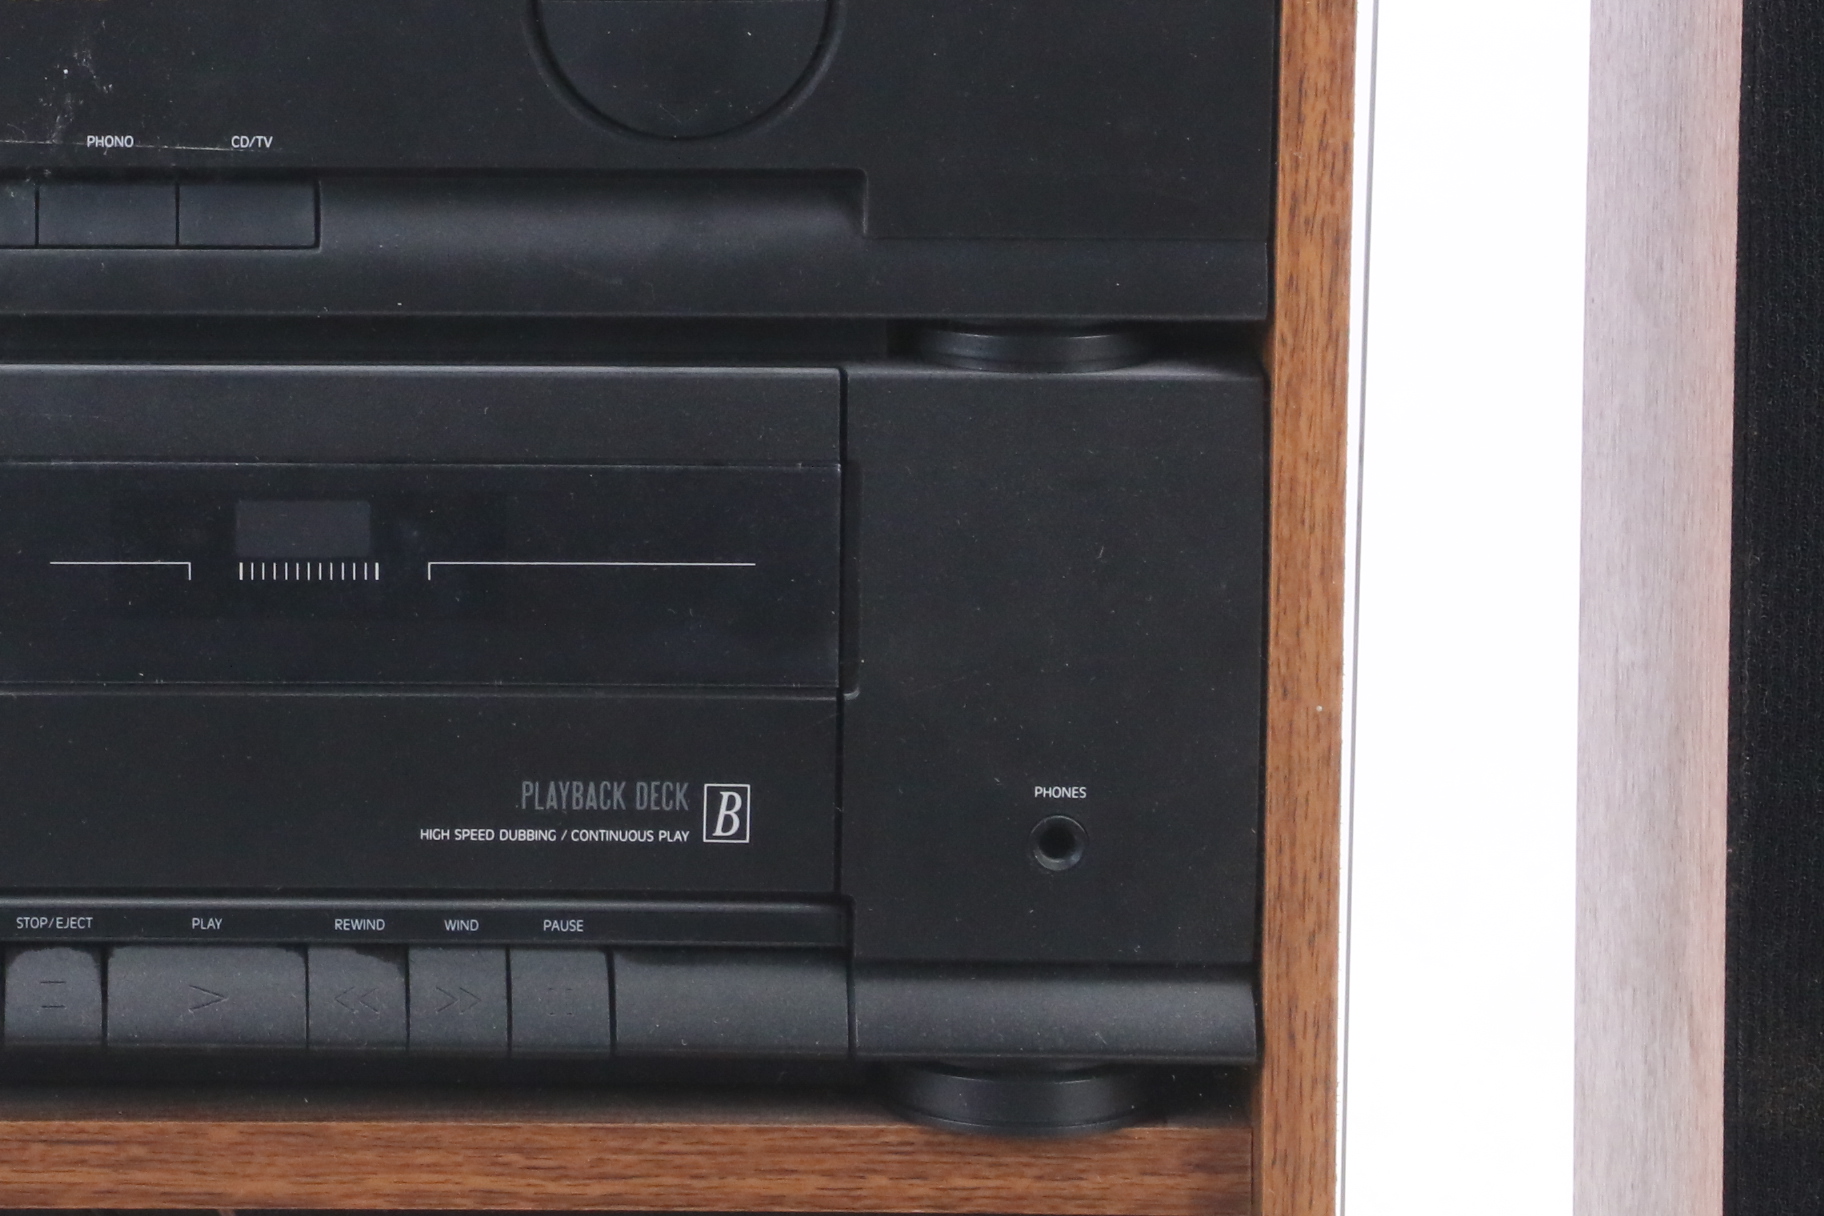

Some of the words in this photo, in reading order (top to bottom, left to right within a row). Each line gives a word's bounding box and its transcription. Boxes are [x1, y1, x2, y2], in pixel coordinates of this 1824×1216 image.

[87, 135, 133, 148] PHONO
[232, 136, 273, 148] CD/TV
[522, 781, 626, 810] PLAYBACK
[636, 782, 688, 810] DECK
[1035, 786, 1086, 798] PHONES
[713, 792, 741, 836] B
[421, 829, 449, 840] HIGH
[455, 829, 494, 840] SPEED
[500, 829, 556, 841] DUBBING
[571, 830, 654, 842] CONTINUOUS
[659, 830, 689, 842] PLAY
[17, 917, 93, 929] STOP/EJECT
[192, 918, 222, 929] PLAY
[335, 919, 385, 930] REWIND
[445, 919, 479, 931] WIND
[544, 920, 583, 932] PAUSE
